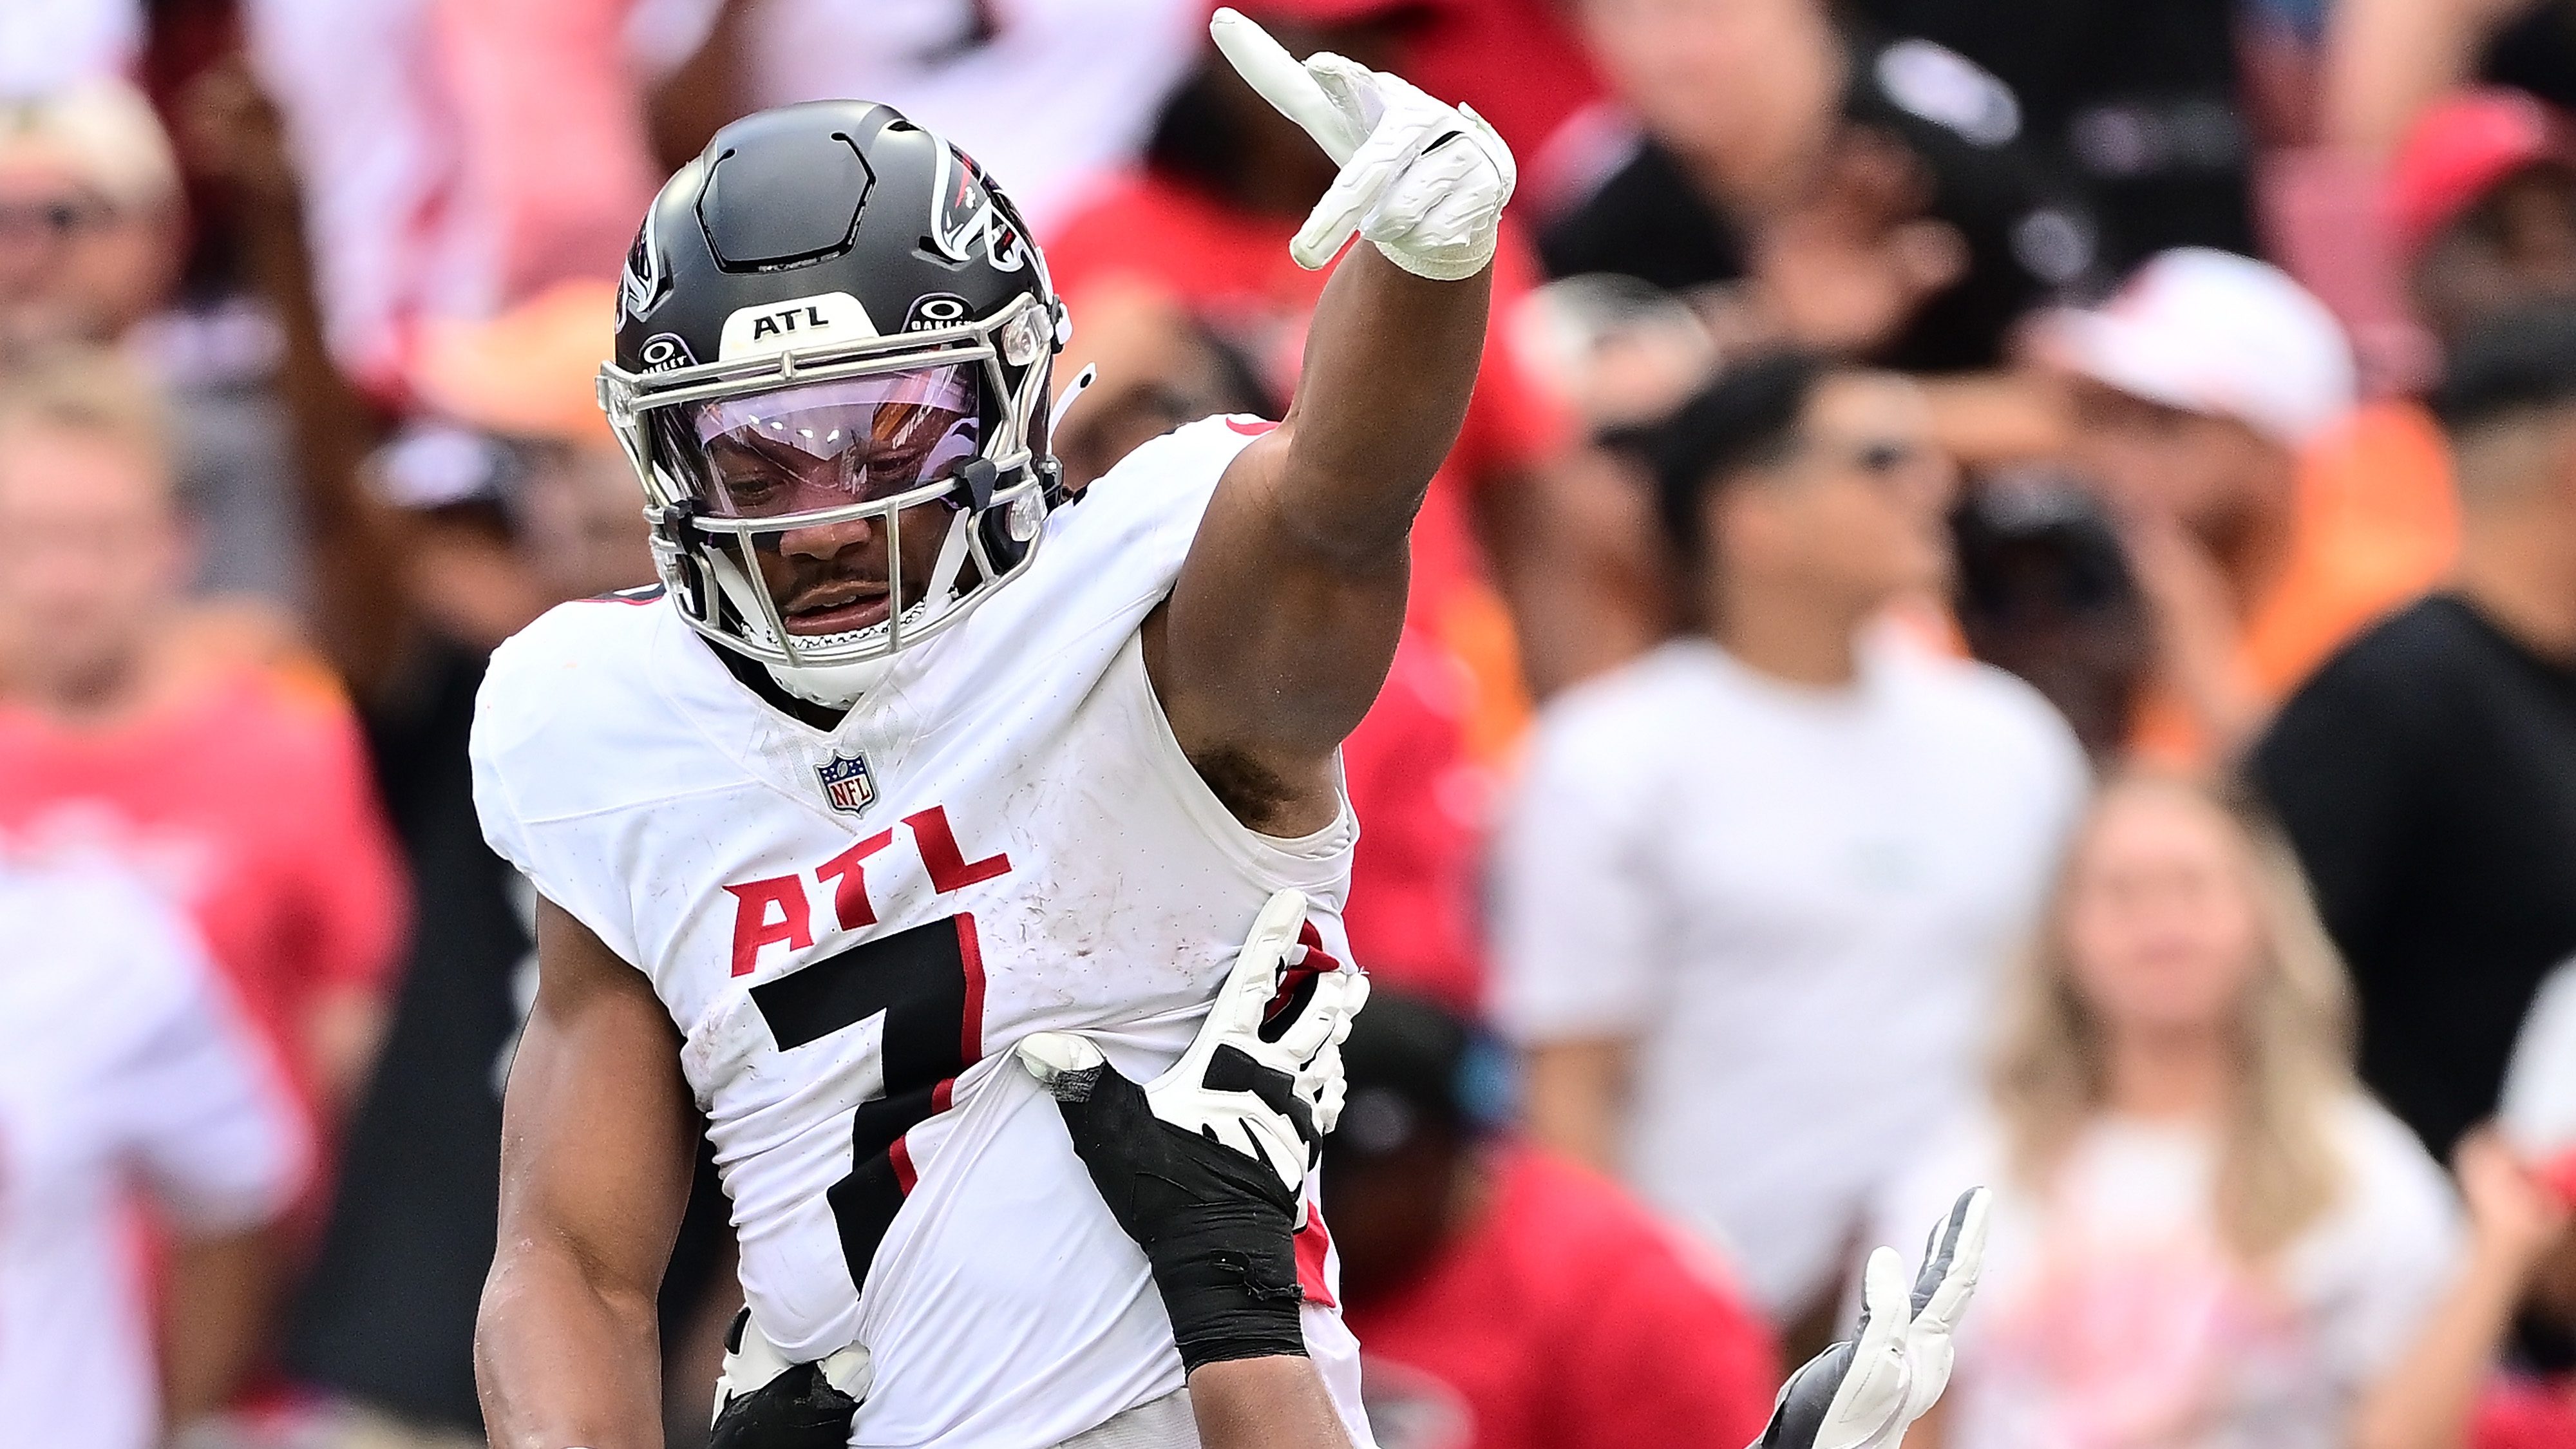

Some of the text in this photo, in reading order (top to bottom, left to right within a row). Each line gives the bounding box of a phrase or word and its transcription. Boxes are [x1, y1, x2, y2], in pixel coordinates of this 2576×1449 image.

[753, 307, 829, 340] ATL
[830, 777, 869, 806] NFL
[722, 805, 1012, 978] ATL
[748, 911, 986, 1302] 7
